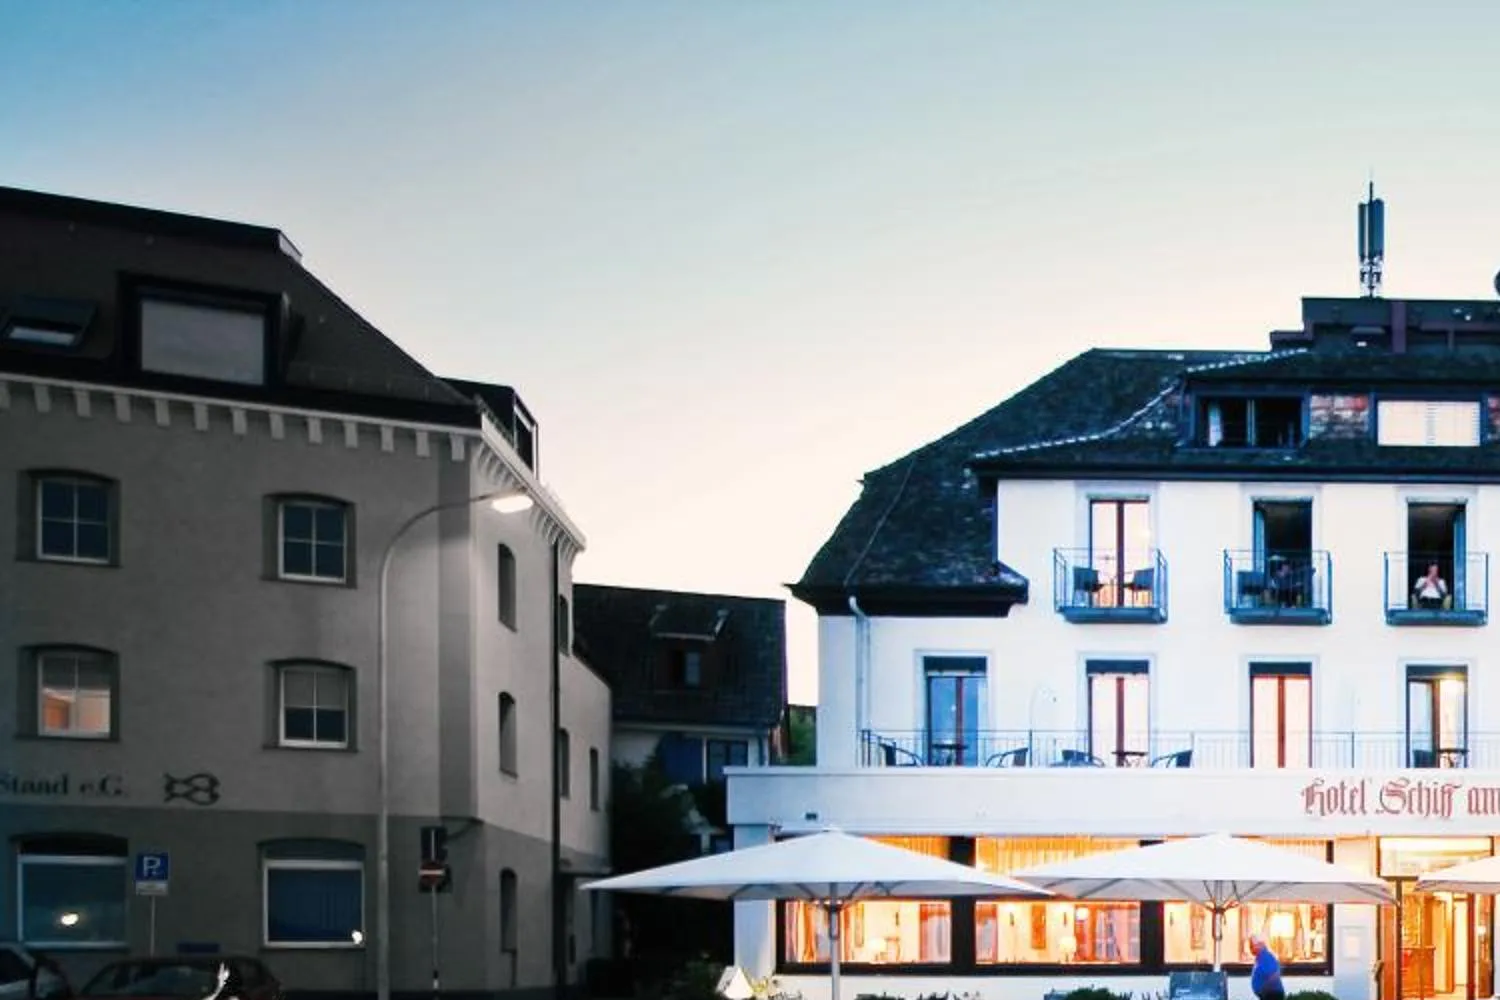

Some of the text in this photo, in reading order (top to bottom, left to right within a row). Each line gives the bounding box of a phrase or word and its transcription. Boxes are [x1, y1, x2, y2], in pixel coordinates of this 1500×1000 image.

[1301, 777, 1368, 817] Hotel
[1375, 777, 1463, 819] Schiff
[143, 856, 161, 877] P
